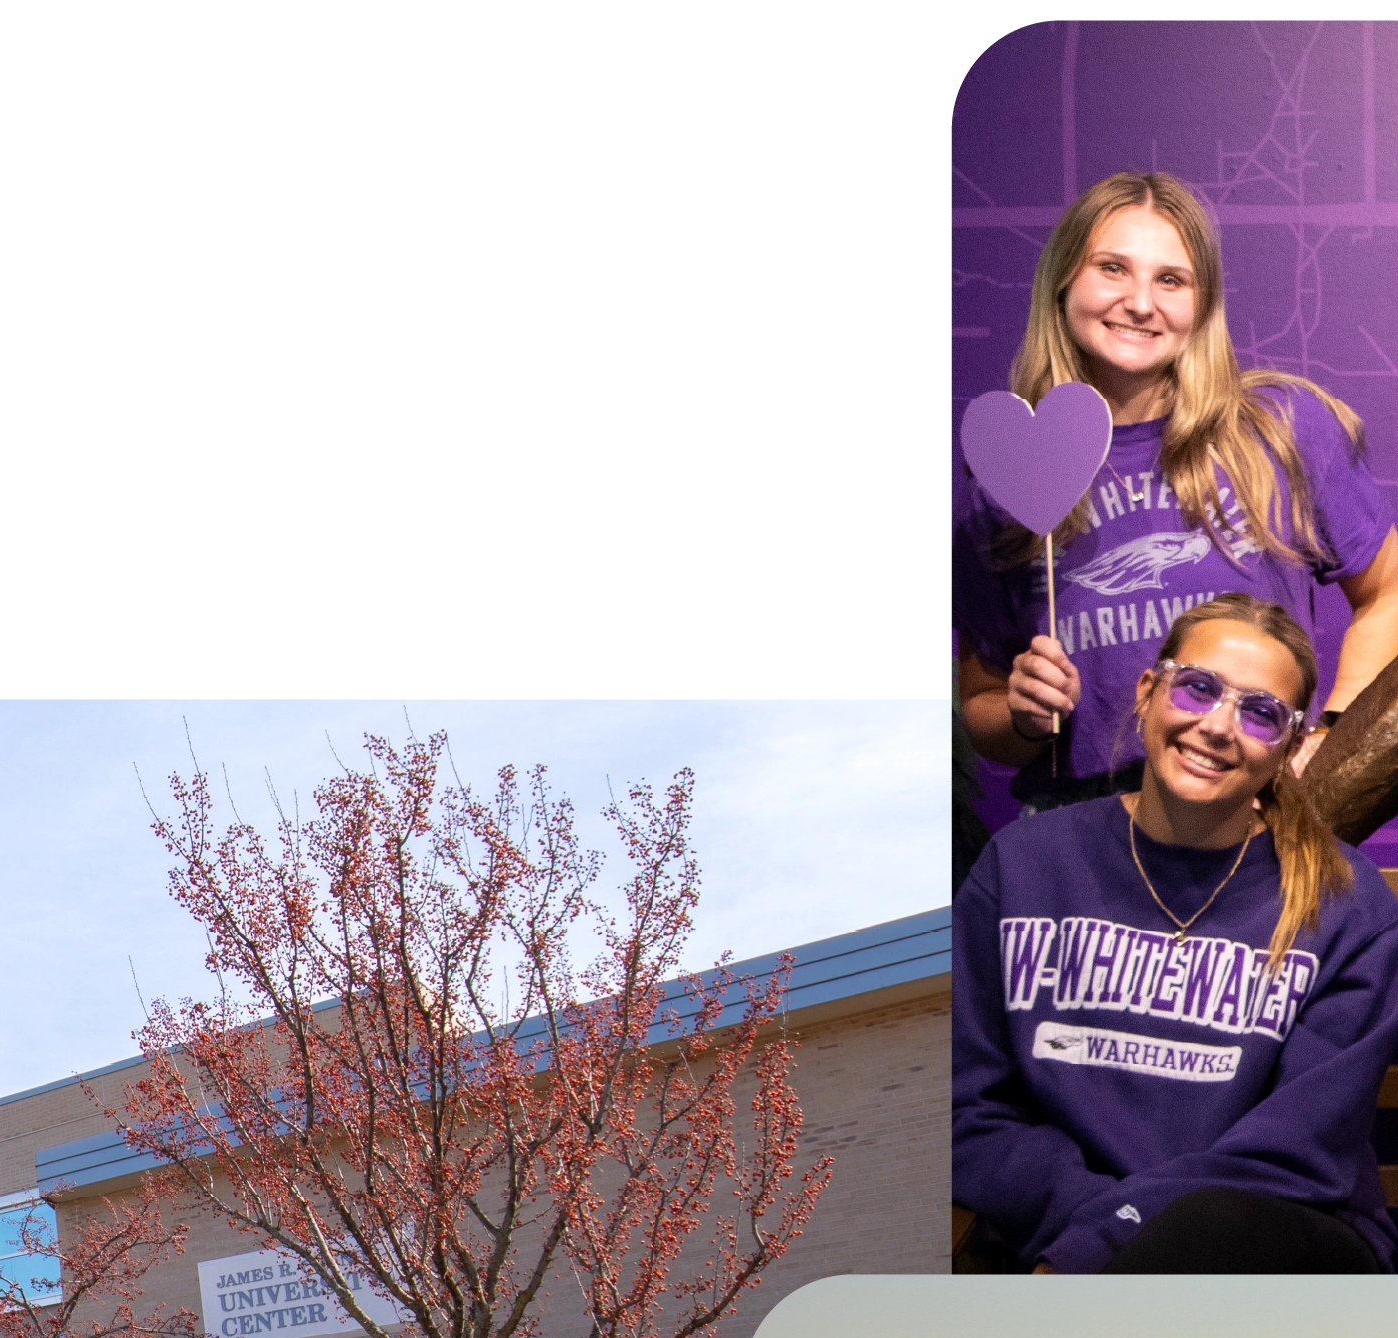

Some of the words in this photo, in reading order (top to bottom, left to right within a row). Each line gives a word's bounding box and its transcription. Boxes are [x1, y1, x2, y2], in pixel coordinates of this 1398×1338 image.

[1086, 1035, 1235, 1075] WARHAWKS
[216, 1265, 274, 1289] JAMES
[277, 1262, 297, 1278] R.
[221, 1302, 328, 1337] CENTER
